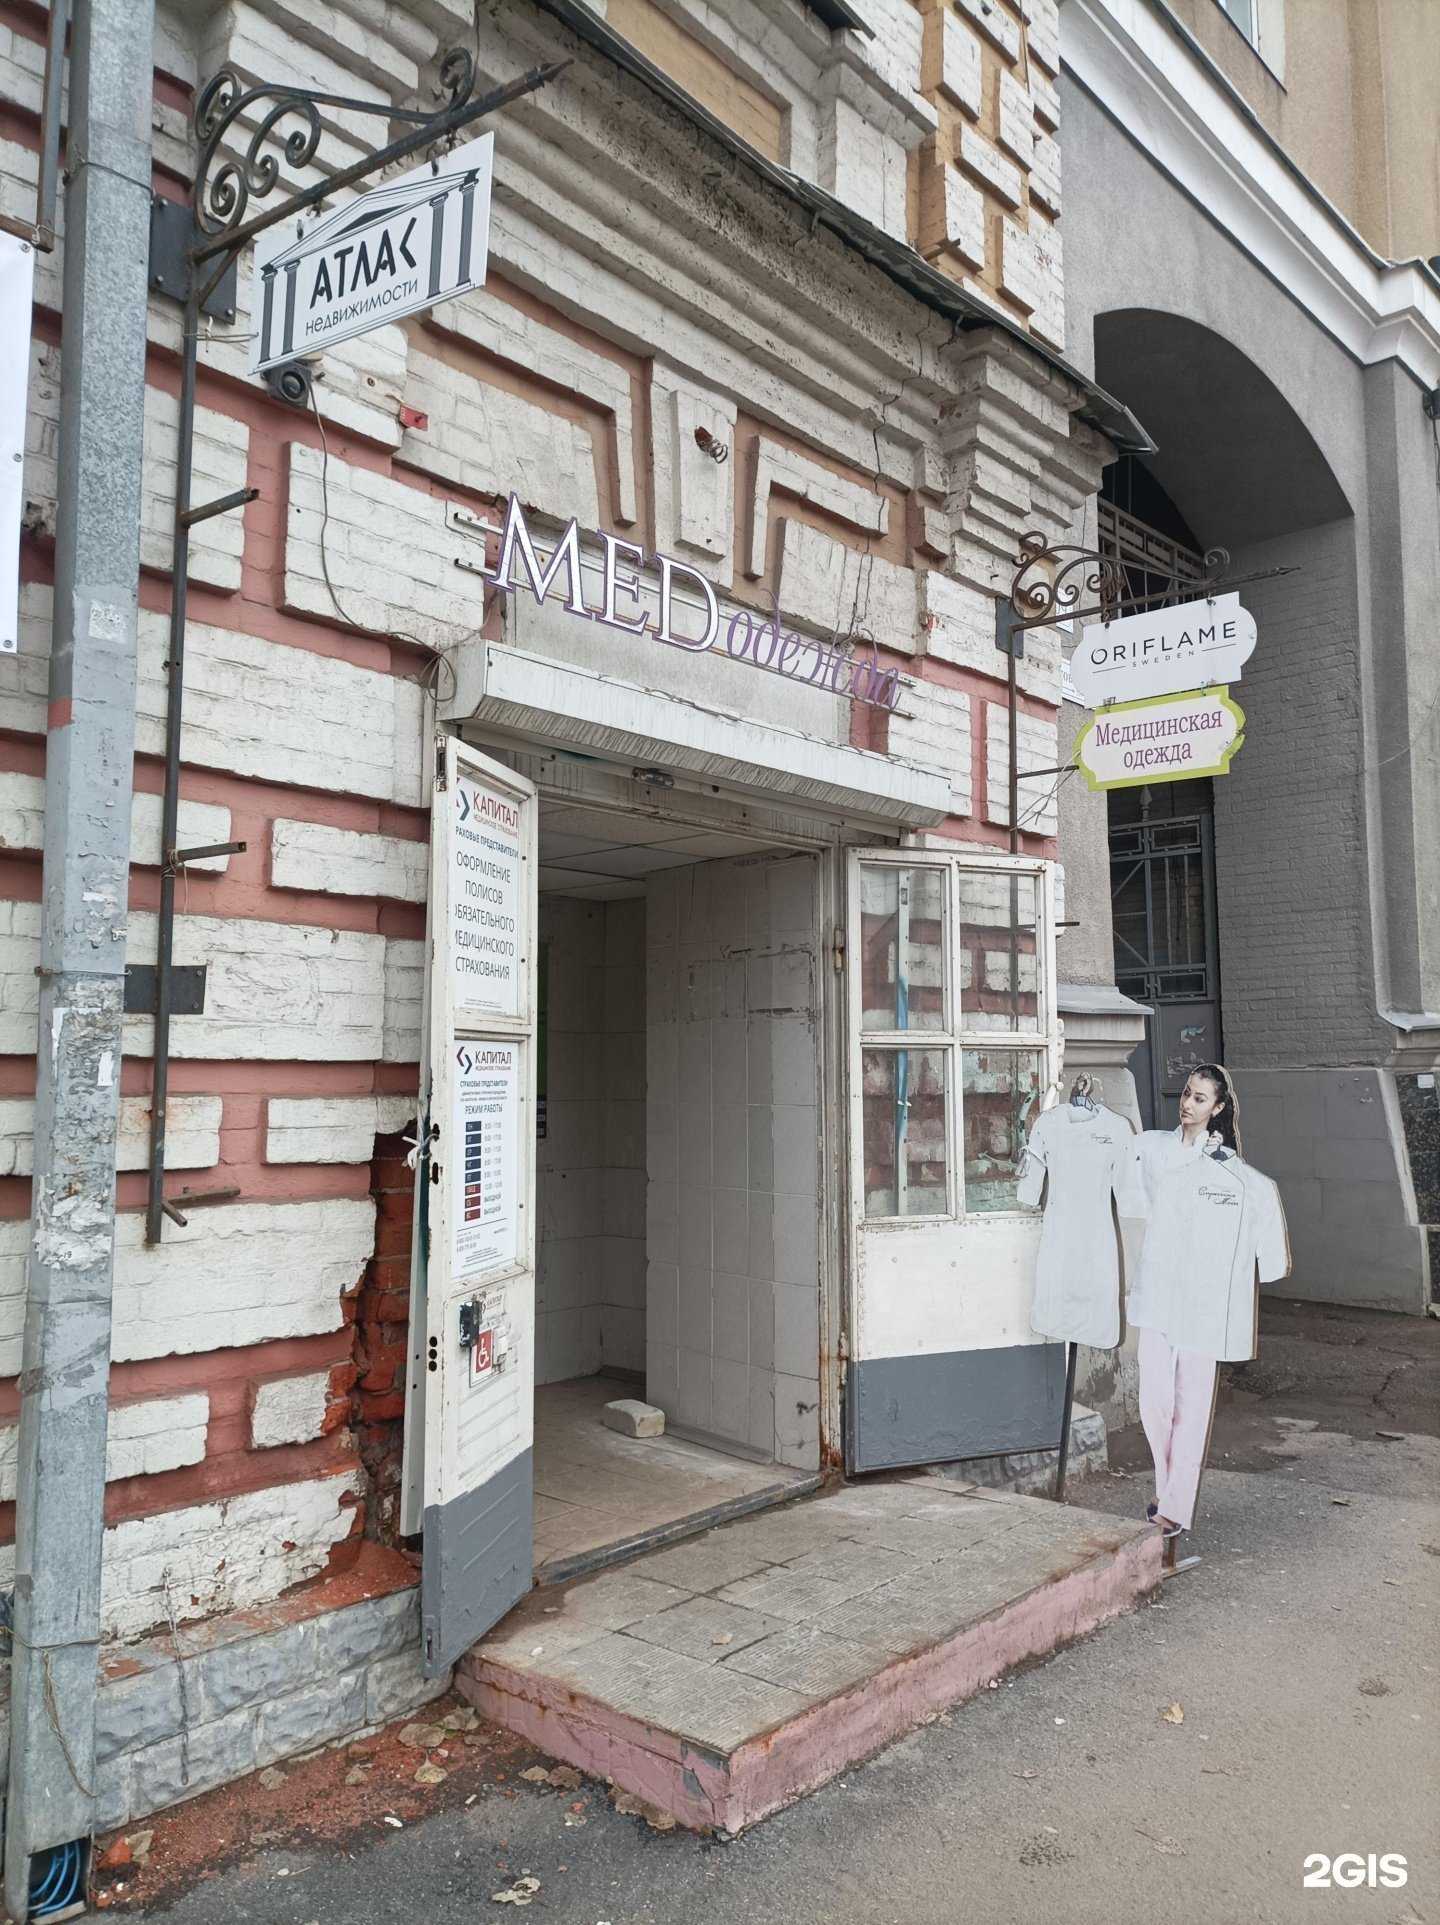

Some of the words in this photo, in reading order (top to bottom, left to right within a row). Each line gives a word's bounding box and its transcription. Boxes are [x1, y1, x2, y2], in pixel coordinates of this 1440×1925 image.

[310, 217, 417, 309] АТЛАС
[305, 278, 418, 336] недвижимости
[486, 492, 719, 652] MED
[1091, 621, 1237, 665] ORIFLAME
[1132, 651, 1194, 667] SWEDEN
[1095, 710, 1223, 747] Медицинская
[1123, 742, 1192, 770] одежда
[473, 791, 519, 829] КАПИТАЛ
[456, 851, 511, 884] ОФОРМЛЕНИЕ
[465, 880, 503, 905] ПОЛИСОВ
[455, 956, 510, 980] СТРАХОВАНИЯ
[475, 1051, 512, 1064] КАПИТАЛ
[465, 1105, 483, 1115] РЕЖИМ
[484, 1103, 503, 1113] РАБОТЫ
